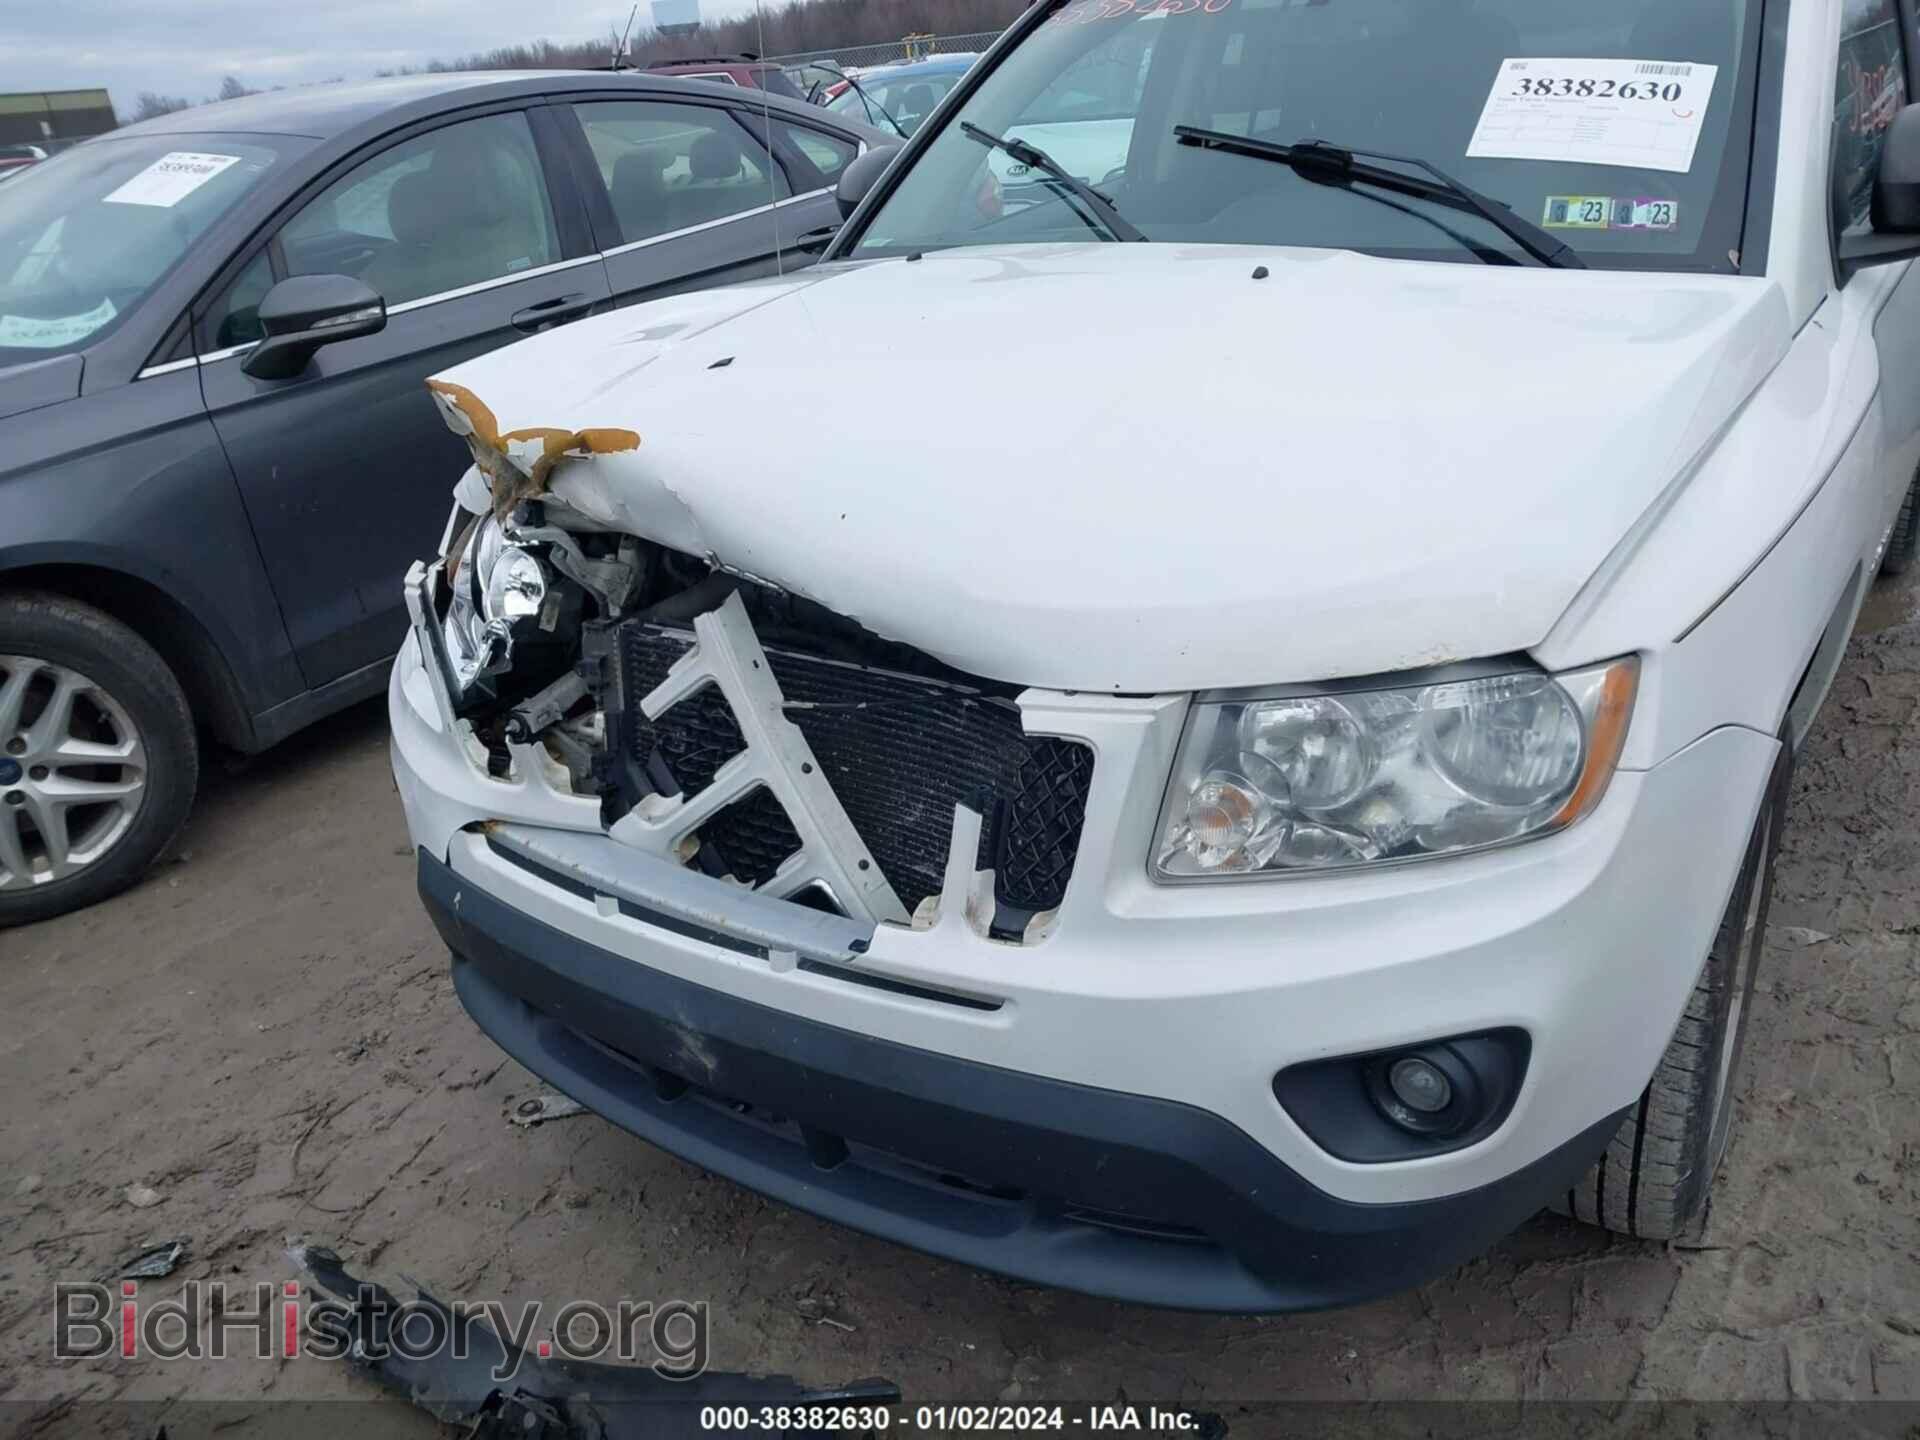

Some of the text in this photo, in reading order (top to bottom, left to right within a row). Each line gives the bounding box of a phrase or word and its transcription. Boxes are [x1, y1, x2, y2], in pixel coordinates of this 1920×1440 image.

[1511, 78, 1682, 101] 38382630
[1584, 201, 1603, 222] 23
[1651, 203, 1671, 225] 23
